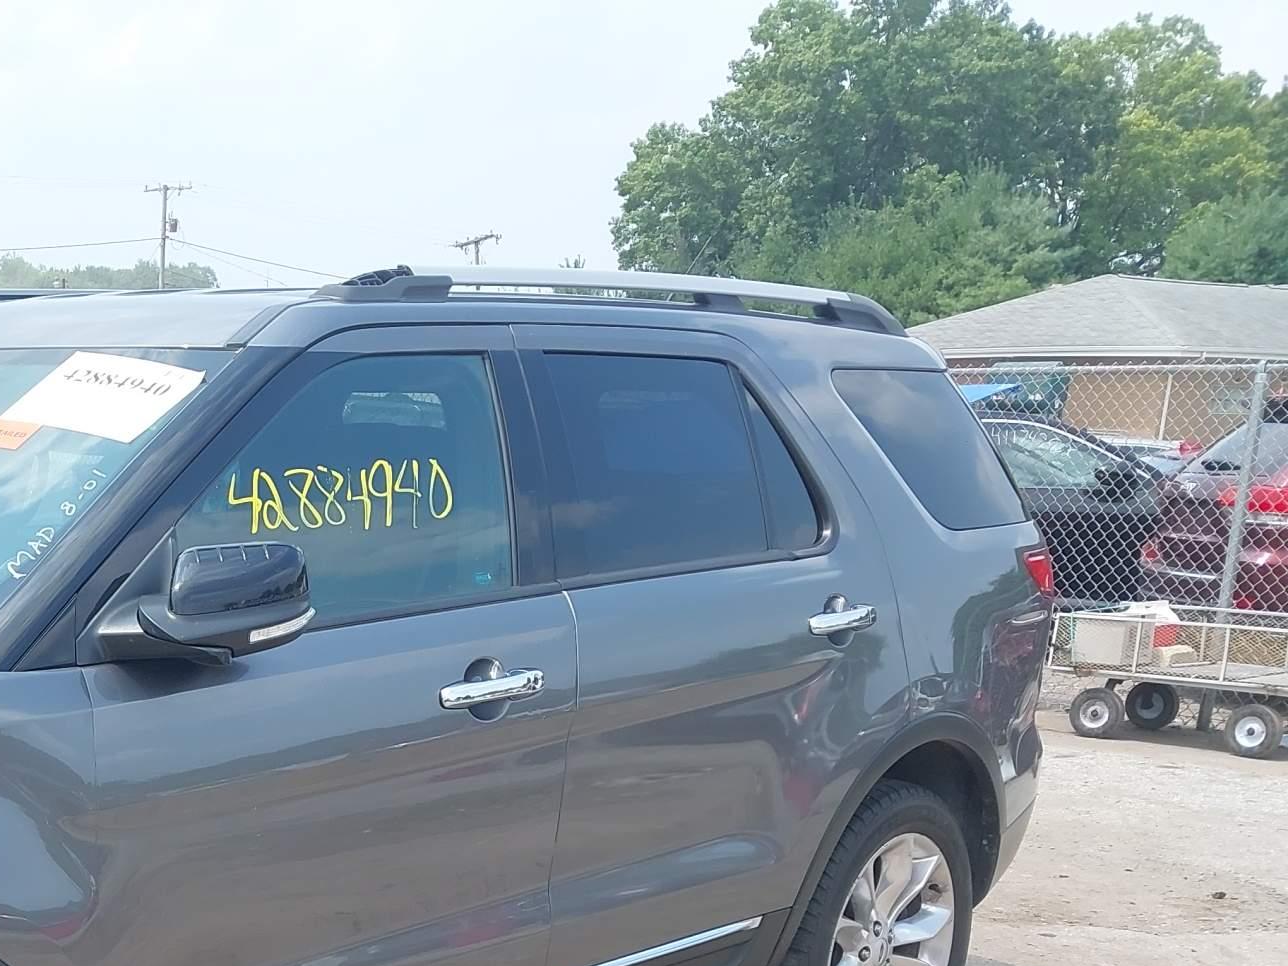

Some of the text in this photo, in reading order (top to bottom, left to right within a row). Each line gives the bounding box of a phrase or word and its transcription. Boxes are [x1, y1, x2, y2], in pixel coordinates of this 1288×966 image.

[63, 368, 172, 397] 42884940
[7, 468, 107, 579] MAD 8-01
[228, 458, 454, 534] 42884940
